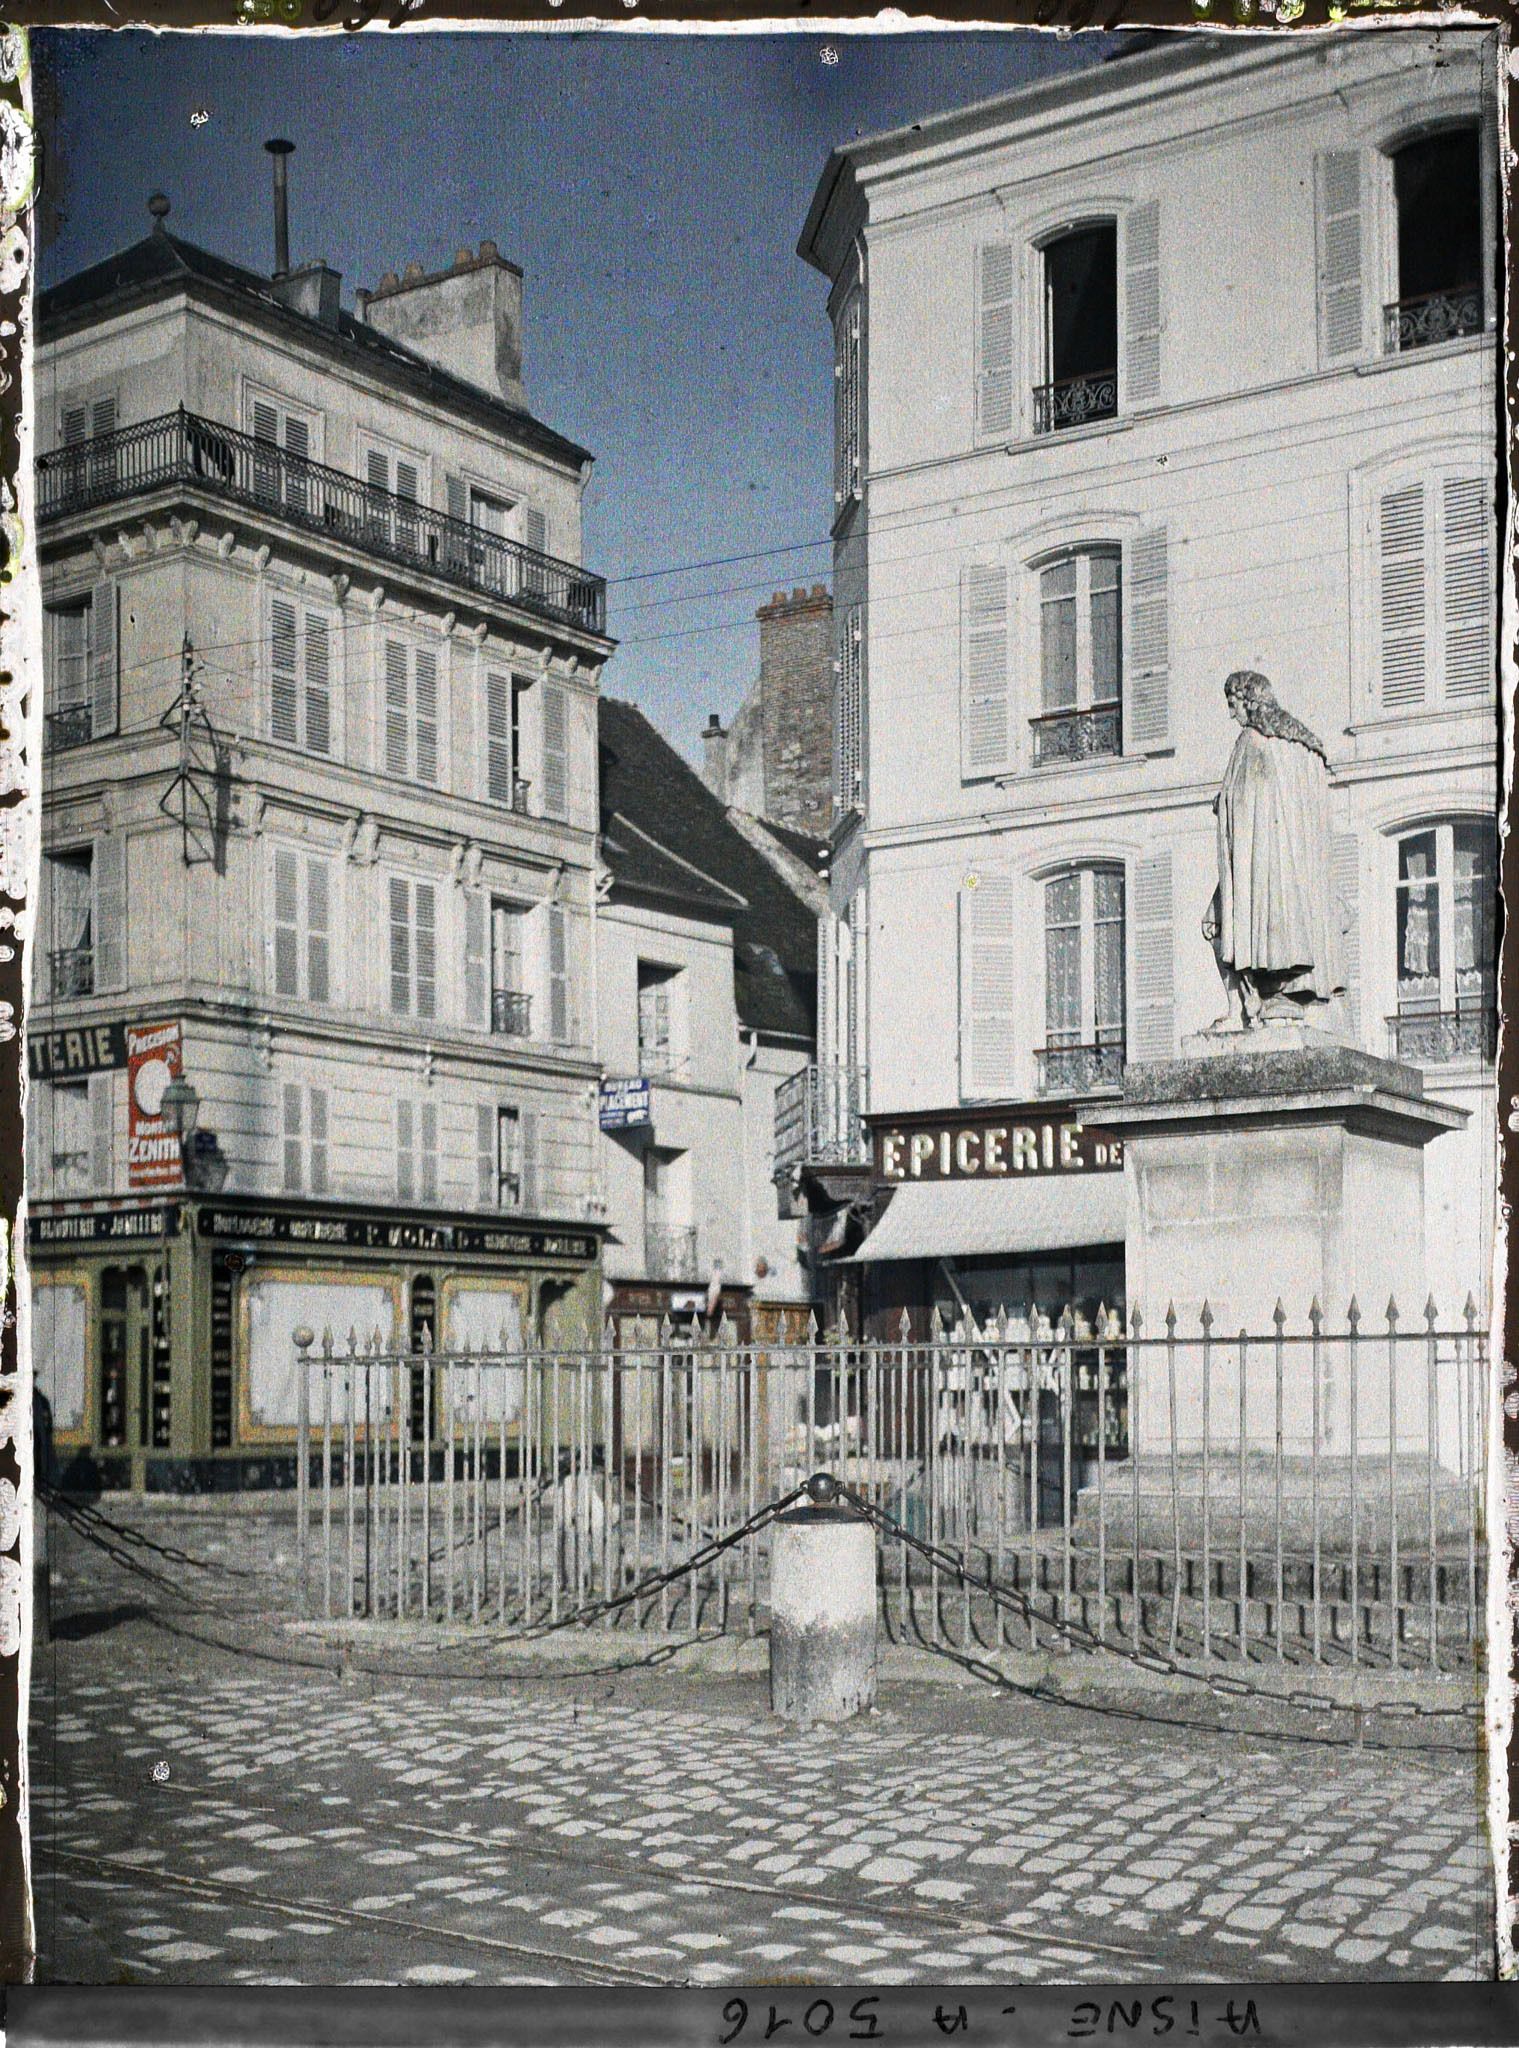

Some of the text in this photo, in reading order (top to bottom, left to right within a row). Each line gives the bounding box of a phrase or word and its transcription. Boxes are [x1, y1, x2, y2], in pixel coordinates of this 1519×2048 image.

[29, 1026, 115, 1072] TERIE
[128, 1136, 181, 1163] ZENITH
[882, 1123, 1122, 1178] ÉPICERIE DE
[718, 1996, 884, 2044] 5016
[932, 2004, 968, 2032] A
[1066, 1996, 1262, 2037] AISNE
